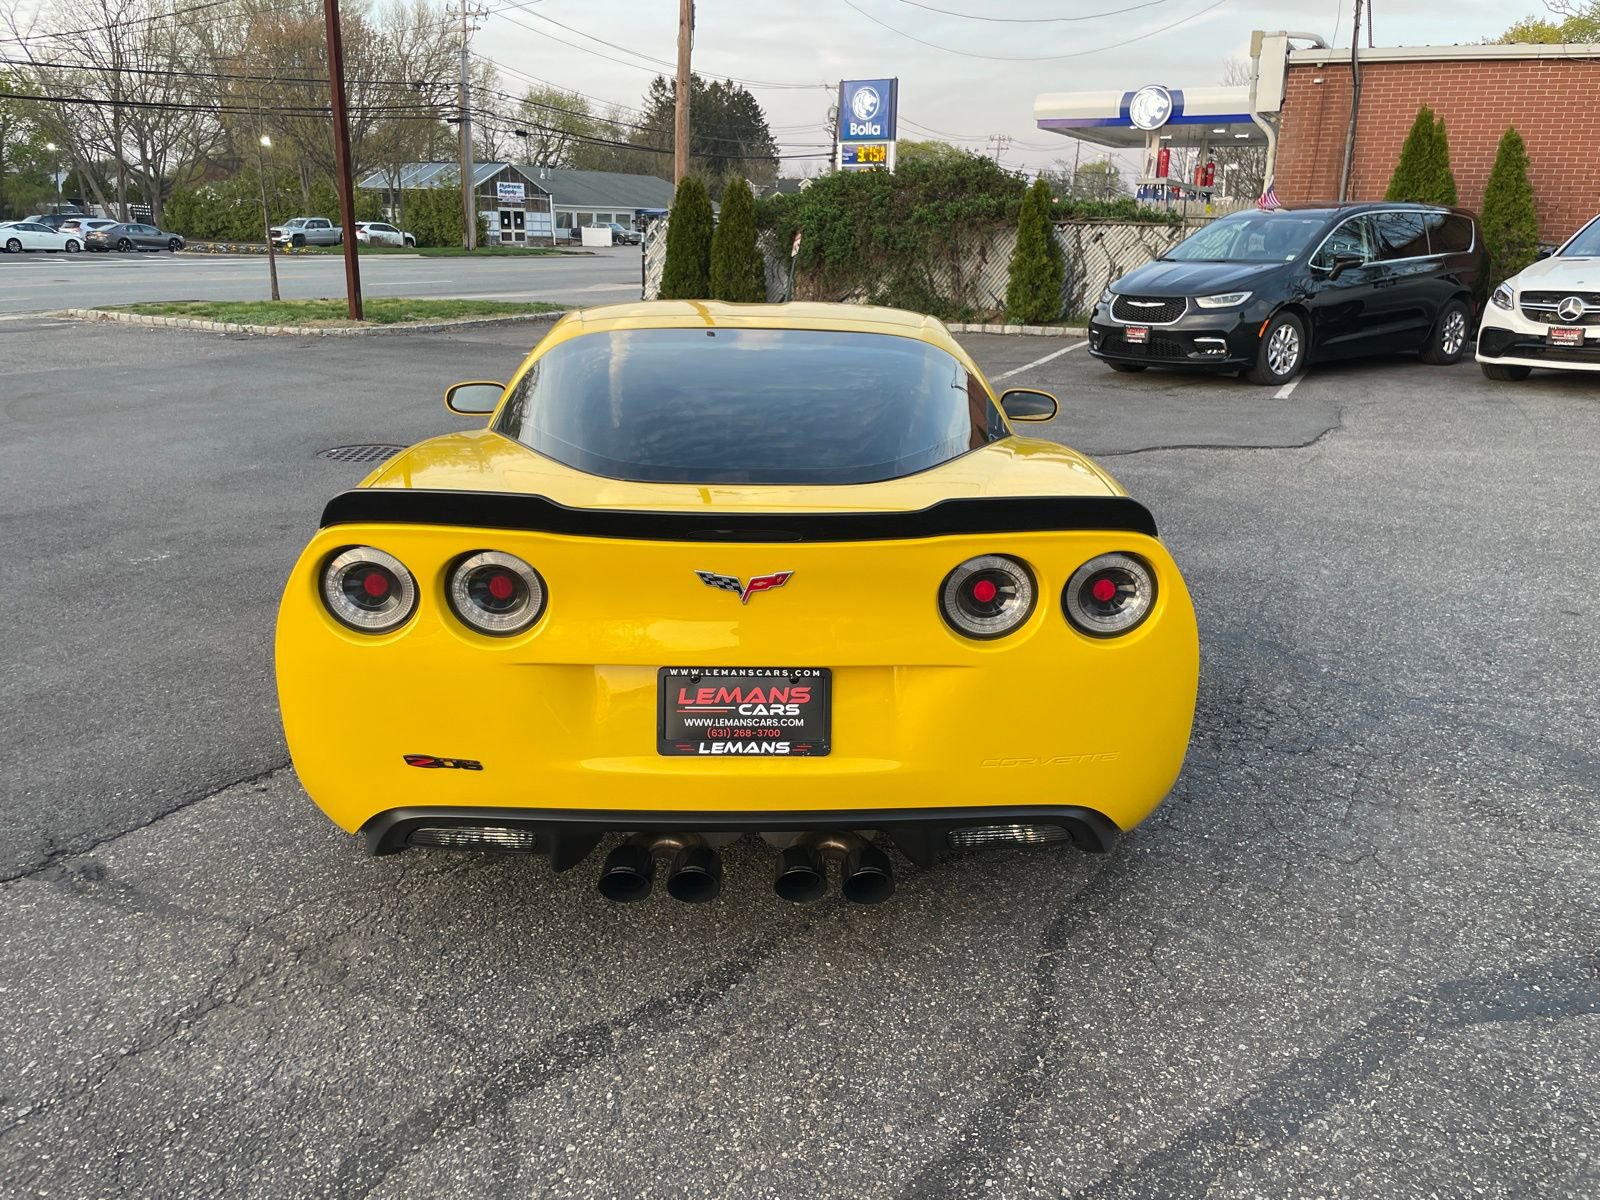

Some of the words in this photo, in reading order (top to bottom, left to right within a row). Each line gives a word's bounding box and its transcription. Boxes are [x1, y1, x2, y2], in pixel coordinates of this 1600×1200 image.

[850, 122, 881, 136] Bolla
[669, 668, 821, 678] WWW.LEMANSCARS.COM
[677, 687, 812, 704] LEMANS
[738, 703, 800, 716] CARS
[684, 718, 804, 727] WWW.LEMANSCARS.COM
[707, 727, 731, 739] (631)
[733, 728, 781, 738] 268-3700
[698, 741, 791, 754] LEMANS
[979, 751, 1121, 768] CORVETTE
